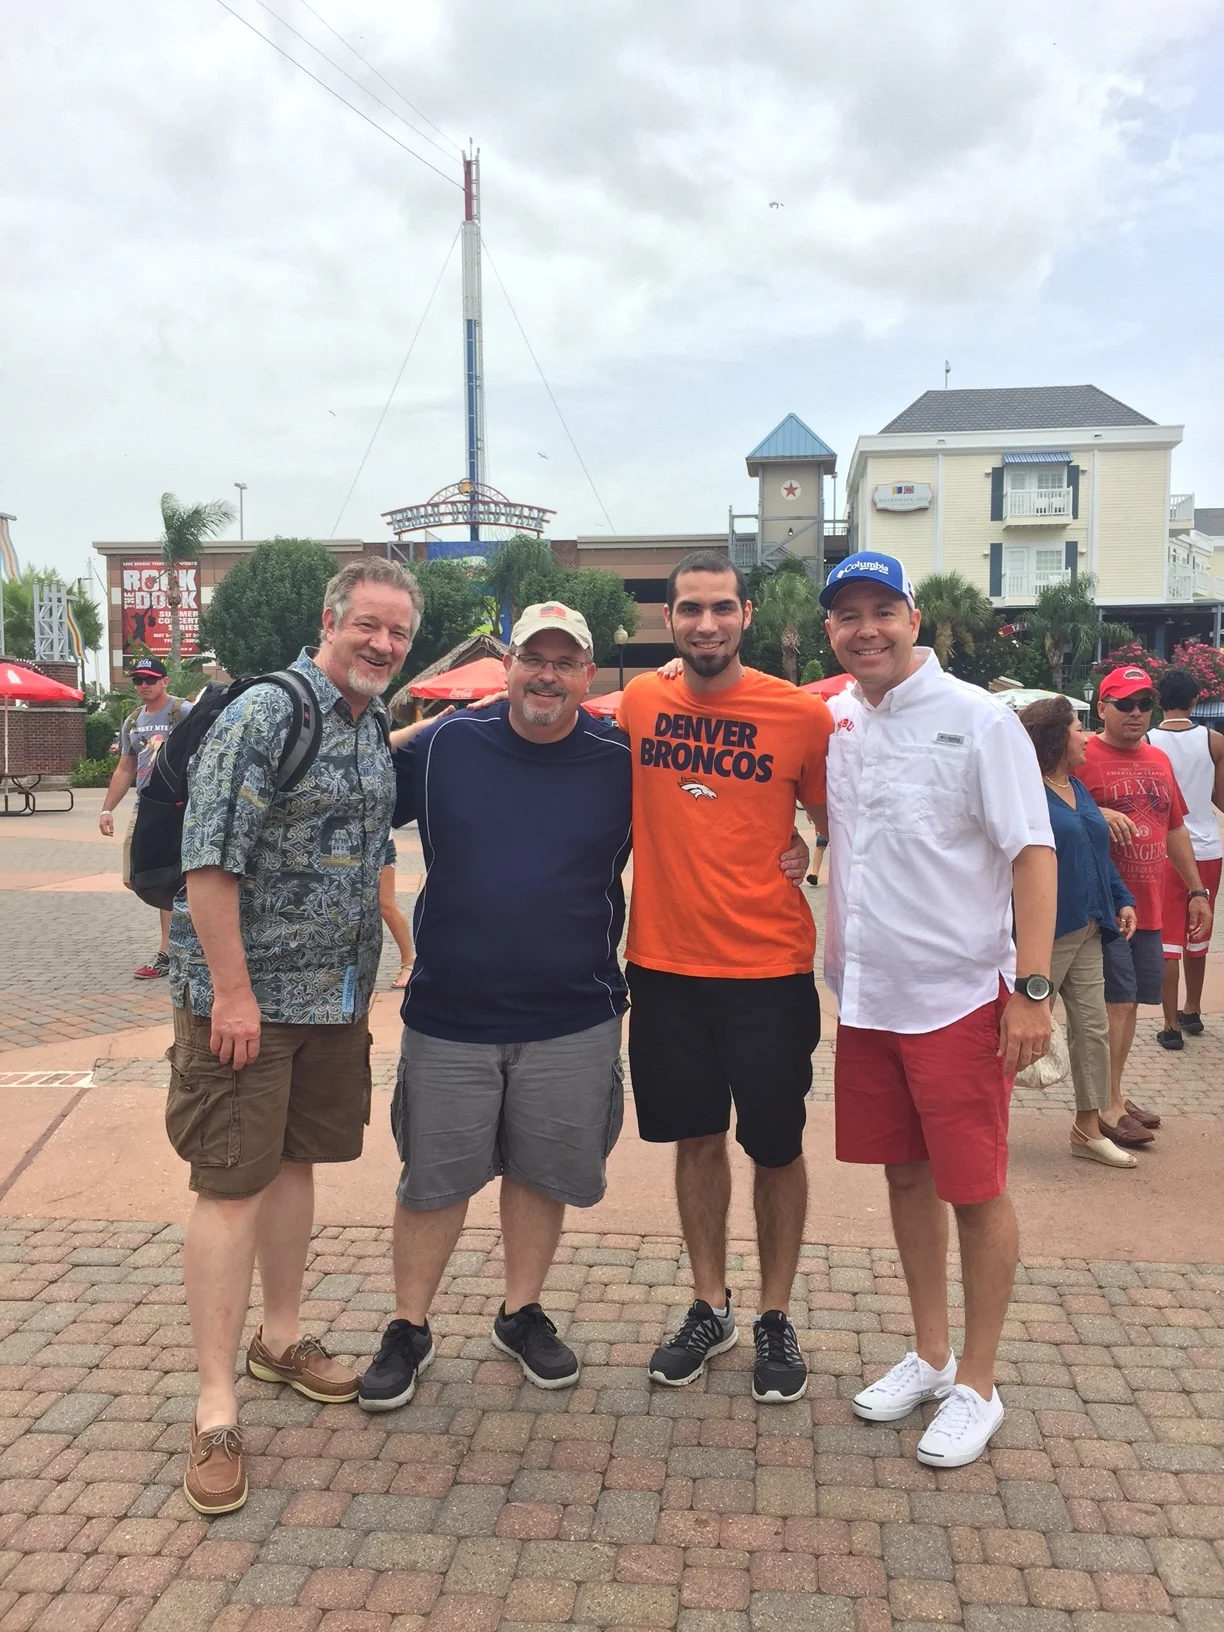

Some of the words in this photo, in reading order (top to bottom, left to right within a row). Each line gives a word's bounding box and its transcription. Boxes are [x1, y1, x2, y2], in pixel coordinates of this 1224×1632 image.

[451, 503, 547, 530] BOARDWALK
[844, 561, 889, 573] Columbia
[124, 592, 135, 609] THE
[654, 712, 758, 749] DENVER
[640, 737, 774, 783] BRONCOS
[1110, 778, 1170, 804] TEXAS
[1111, 841, 1166, 862] ANGER
